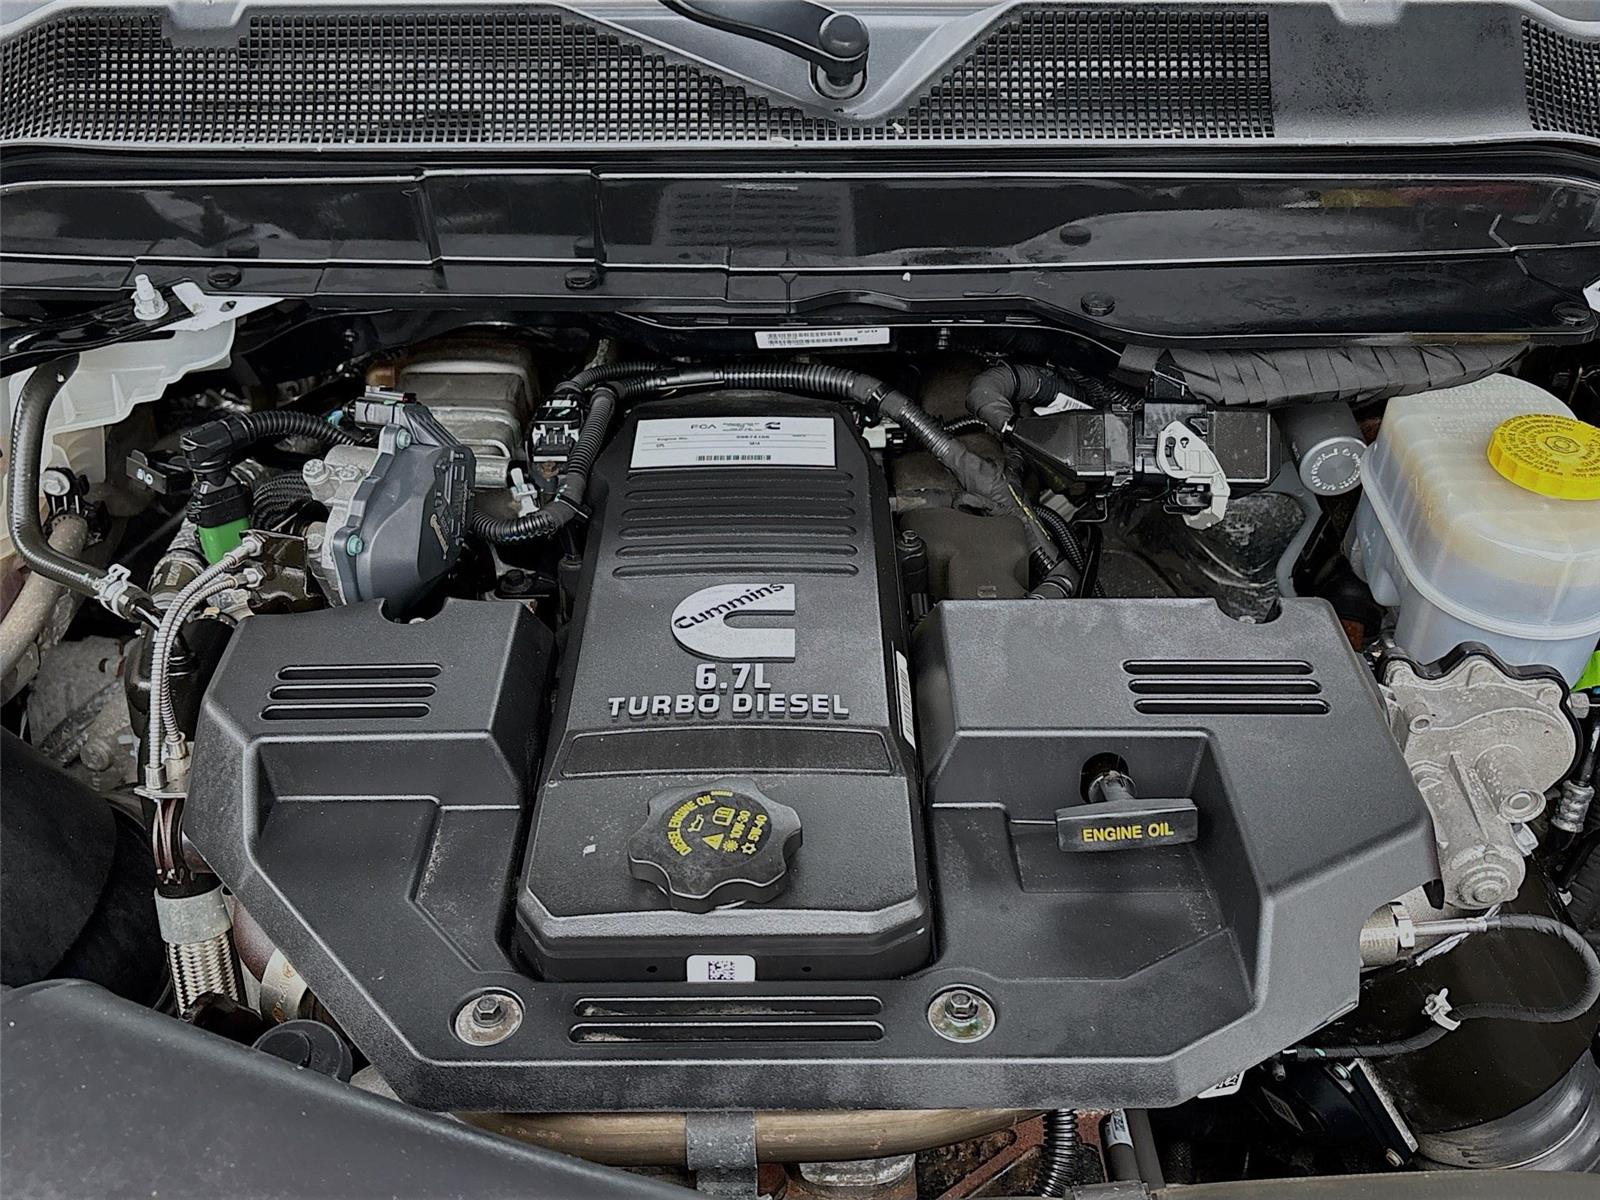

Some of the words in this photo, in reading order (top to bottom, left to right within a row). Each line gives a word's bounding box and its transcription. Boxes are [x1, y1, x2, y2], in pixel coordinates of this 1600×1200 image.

[674, 583, 785, 629] Cummins
[695, 663, 772, 690] 6.7L
[608, 694, 721, 717] TURBO
[732, 693, 849, 715] DIESEL
[696, 795, 716, 806] OIL
[668, 801, 698, 828] ENGINE
[747, 814, 768, 842] 5W-40
[667, 829, 693, 857] DIESEL
[1082, 825, 1142, 842] ENGINE
[1147, 822, 1175, 838] OIL
